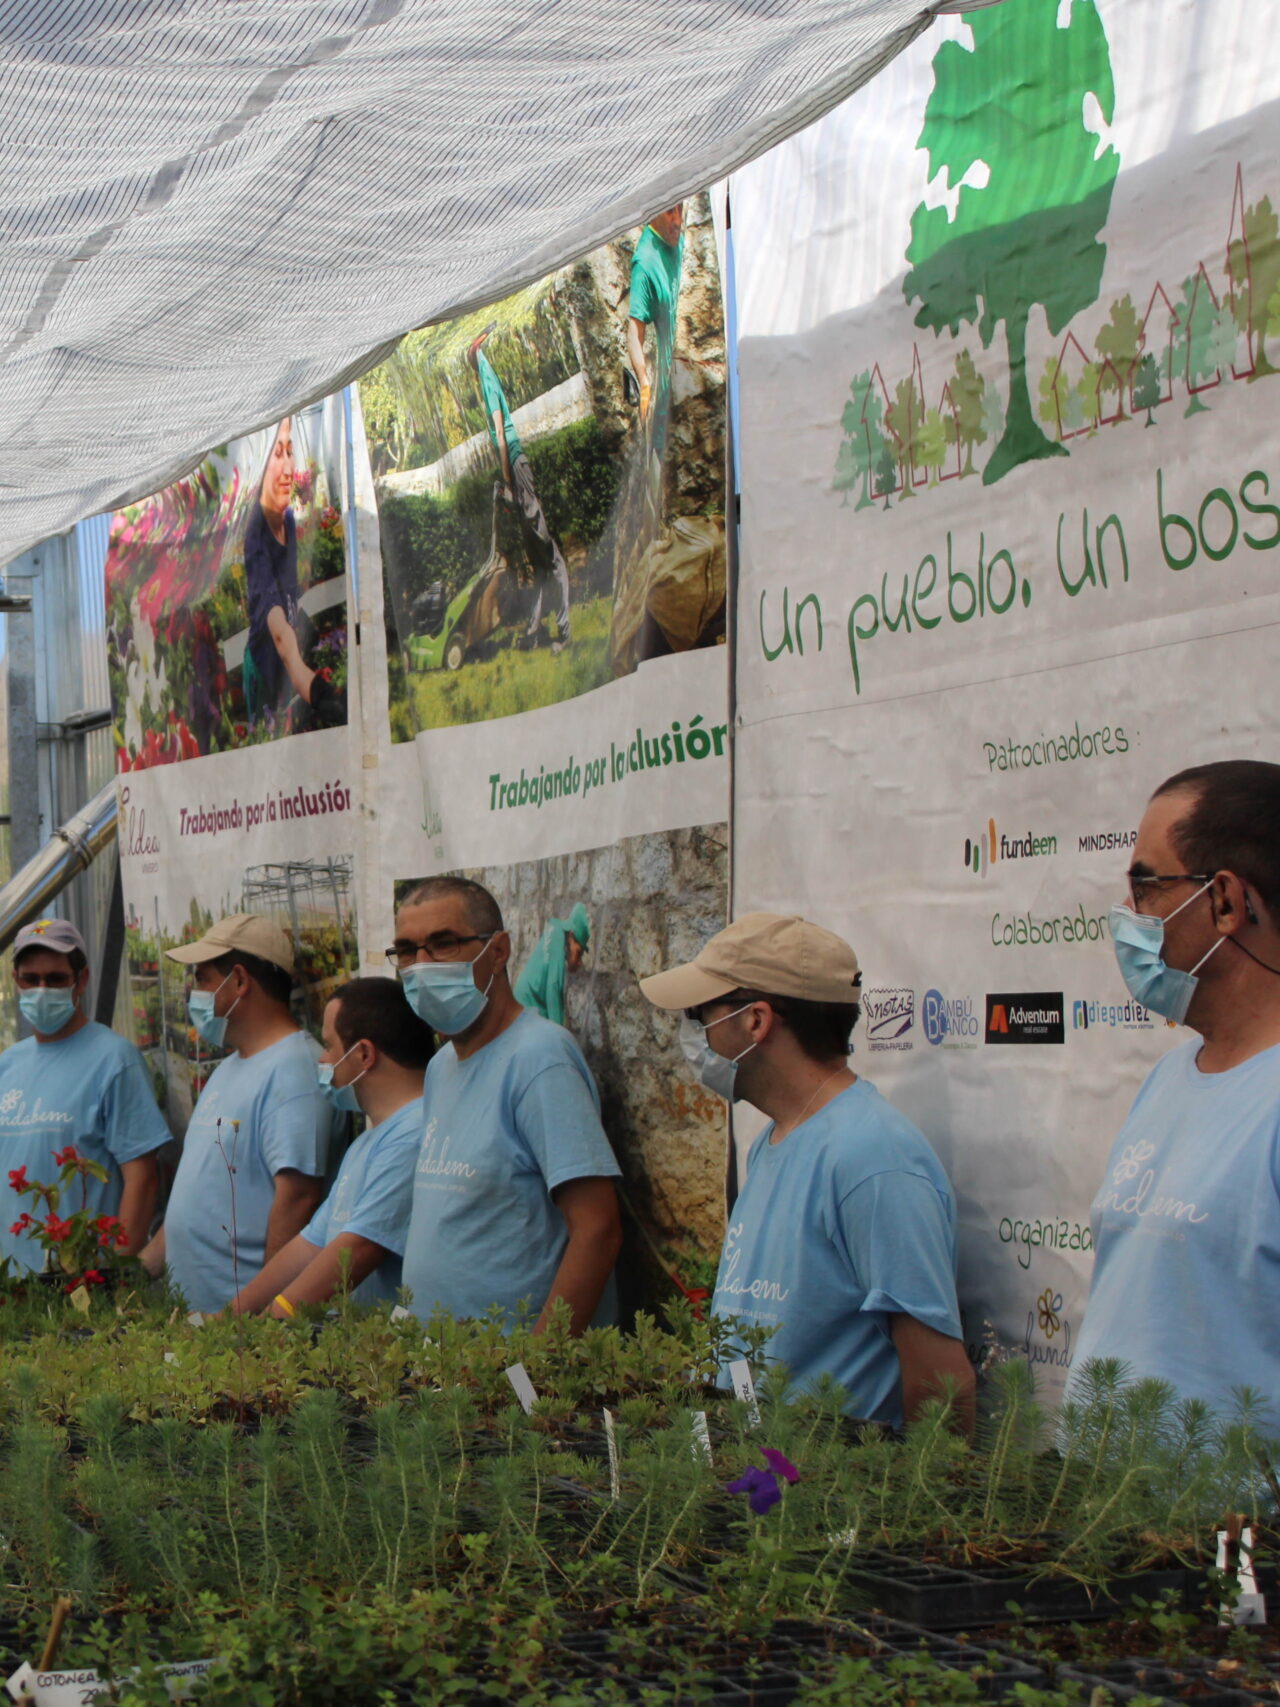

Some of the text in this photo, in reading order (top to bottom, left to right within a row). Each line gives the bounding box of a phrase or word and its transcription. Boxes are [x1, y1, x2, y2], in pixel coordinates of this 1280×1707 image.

[1156, 466, 1280, 572] bos
[489, 755, 581, 811] Trabajando
[582, 756, 607, 799] por
[609, 741, 626, 784] la
[179, 798, 243, 836] Trabajando
[245, 802, 266, 832] por
[266, 792, 277, 822] la
[1001, 831, 1057, 859] fundeen
[991, 903, 1111, 946] Colaborador
[1009, 1006, 1059, 1025] Adventum
